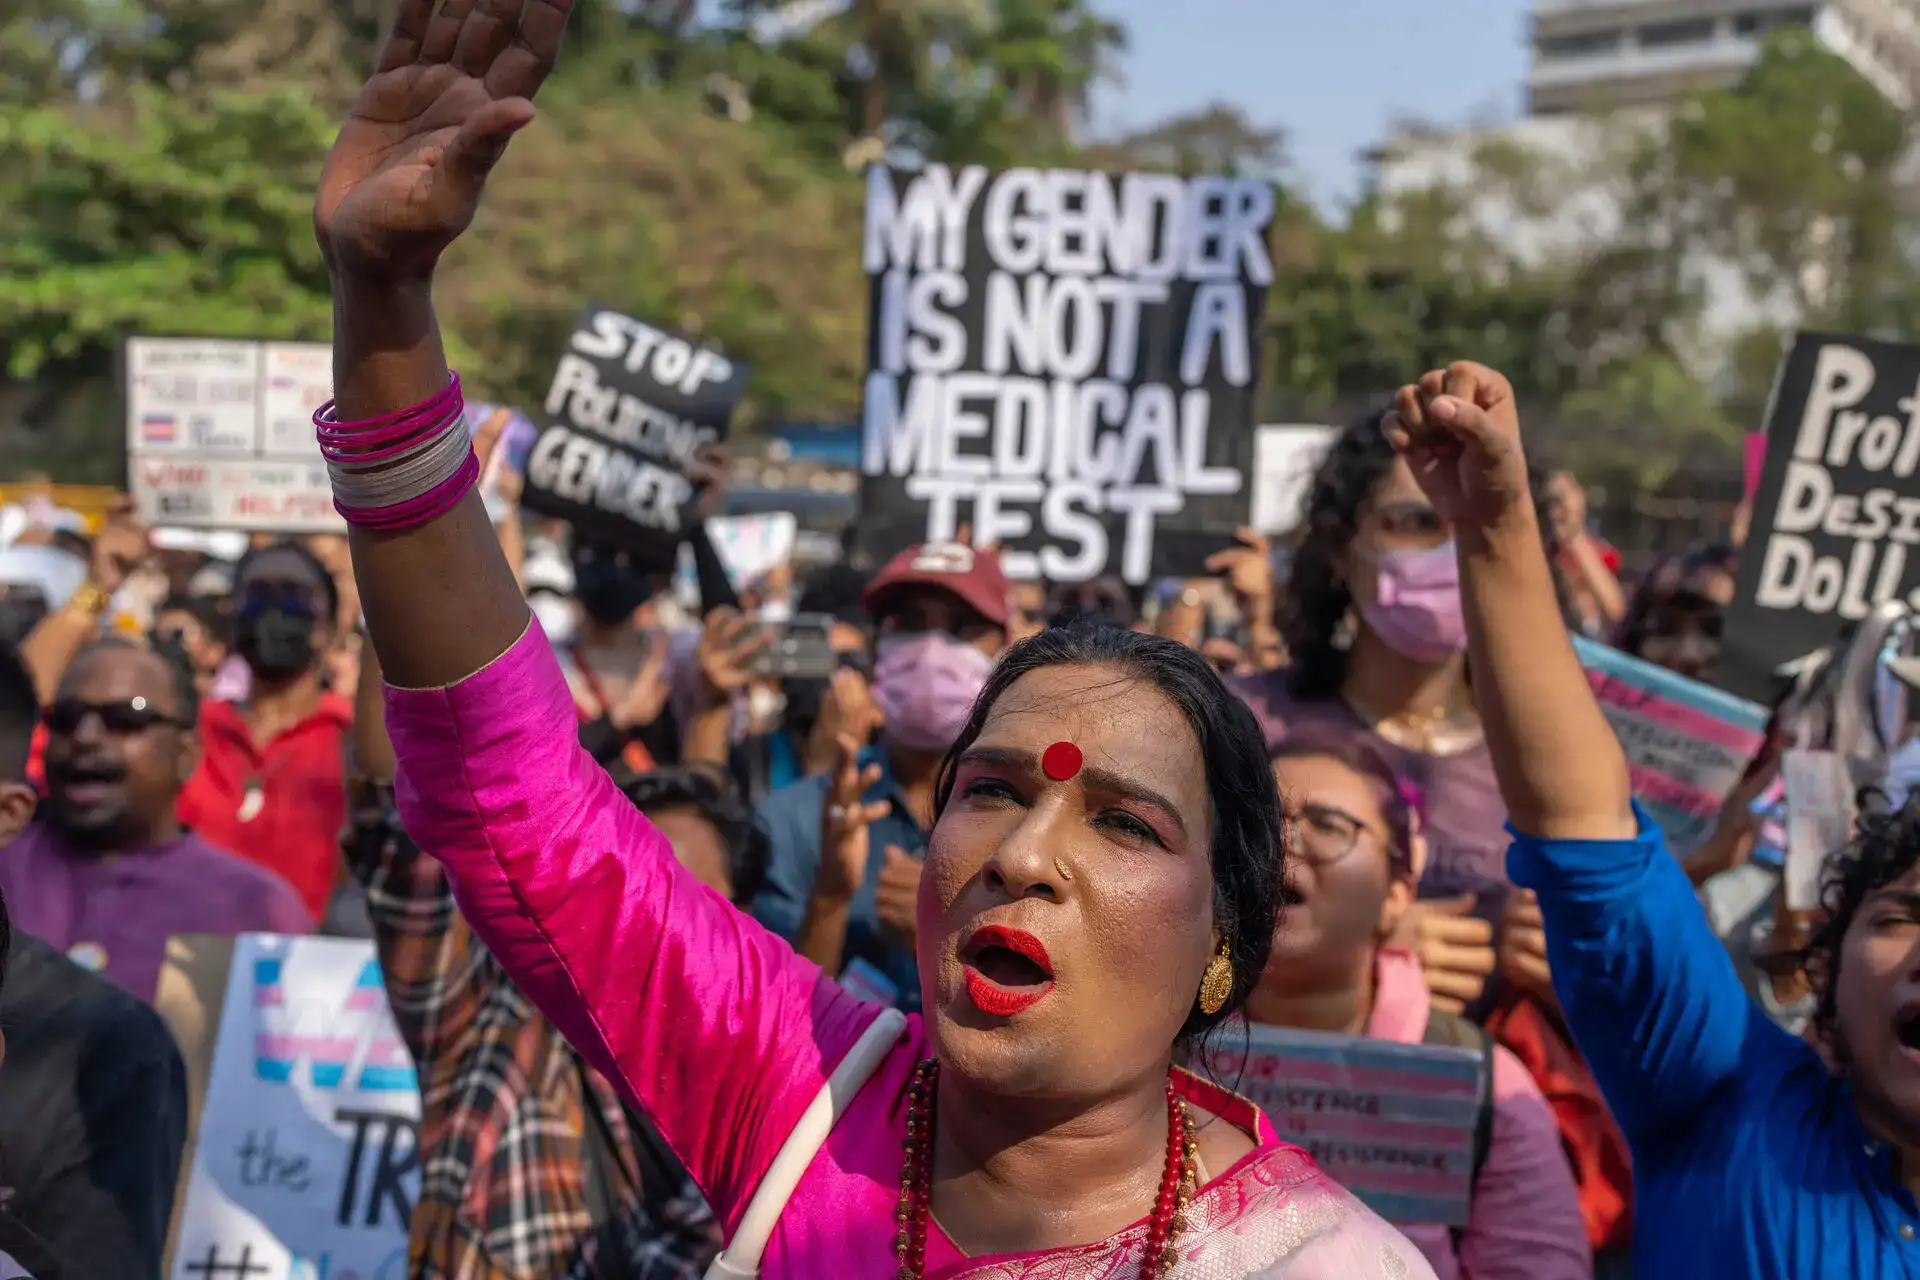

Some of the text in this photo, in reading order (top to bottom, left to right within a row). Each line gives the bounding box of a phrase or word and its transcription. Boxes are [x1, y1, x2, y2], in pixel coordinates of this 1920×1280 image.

[864, 164, 1274, 285] MY GENDER
[571, 311, 732, 395] STOP
[881, 271, 1250, 386] IS NOT A
[529, 425, 692, 532] GENDER
[862, 371, 1241, 493] MEDICAL
[907, 477, 1184, 584] TEST
[235, 1127, 311, 1193] the
